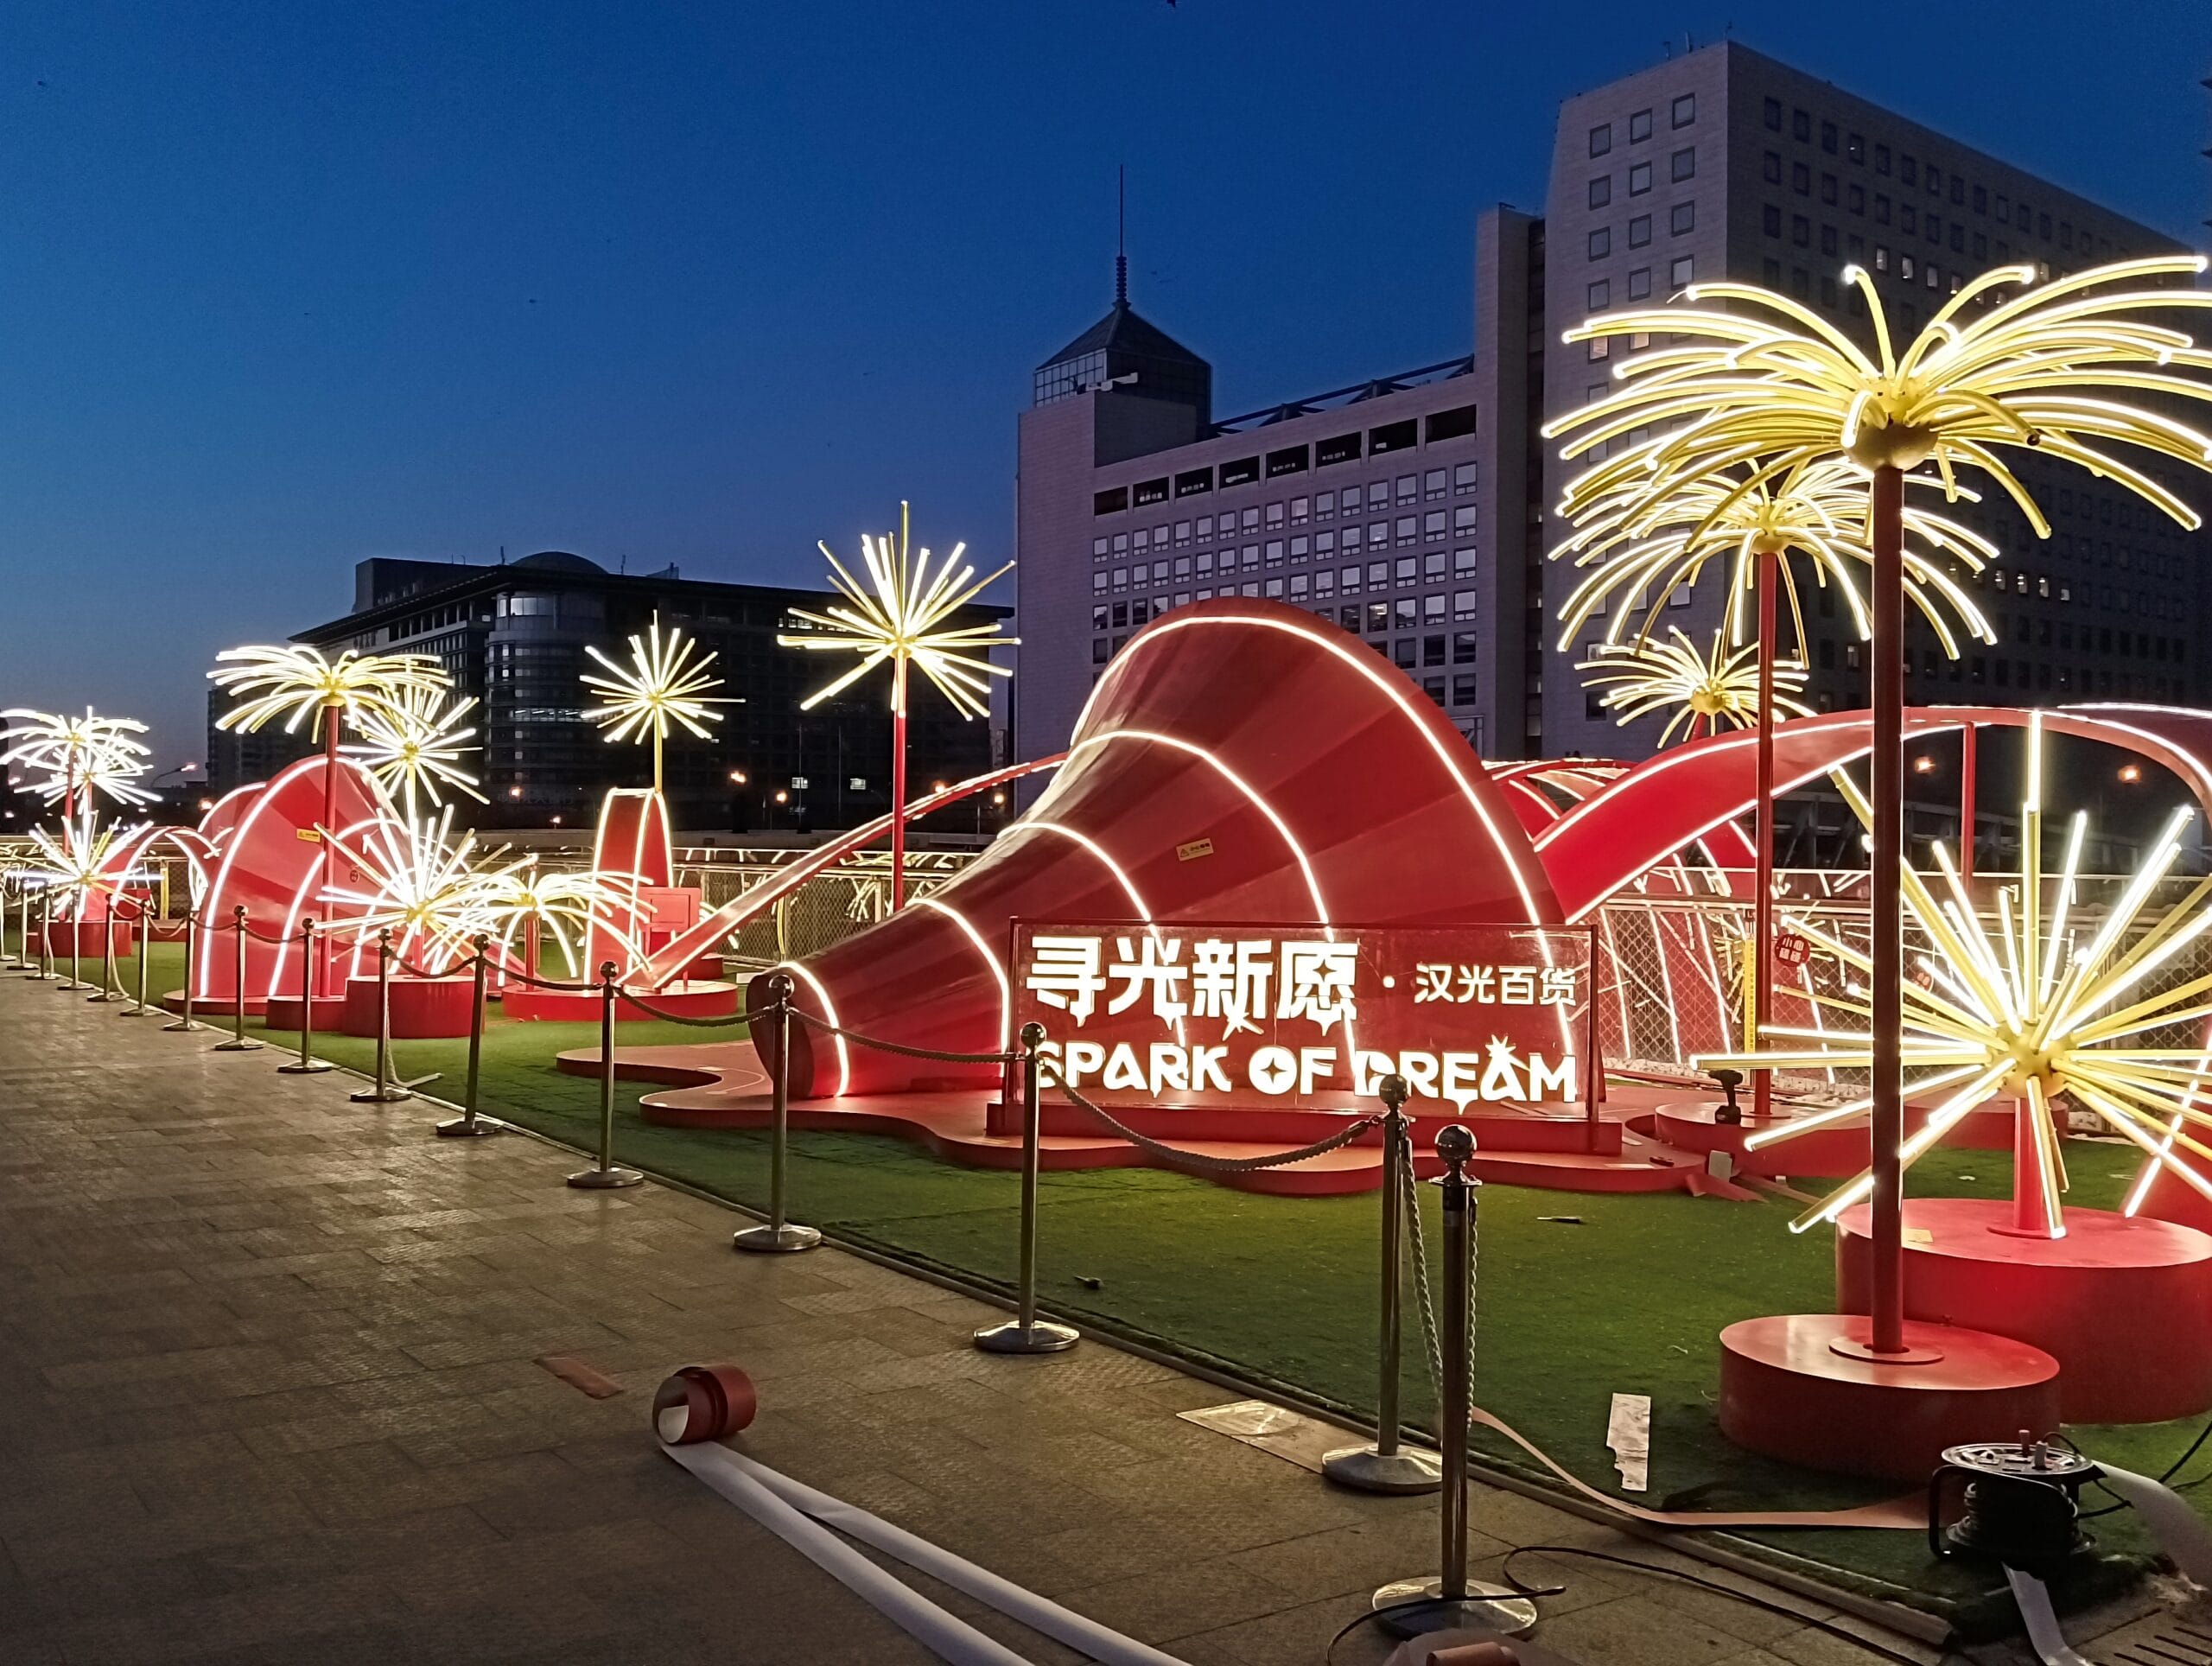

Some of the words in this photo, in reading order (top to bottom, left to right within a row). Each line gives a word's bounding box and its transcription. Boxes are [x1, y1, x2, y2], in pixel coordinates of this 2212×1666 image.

[1027, 936, 1359, 1039] 寻光新愿
[1414, 963, 1577, 1006] 汉光百货
[1027, 1040, 1232, 1098] SPARK
[1249, 1046, 1337, 1096] OF
[1355, 1034, 1576, 1115] DREAM
